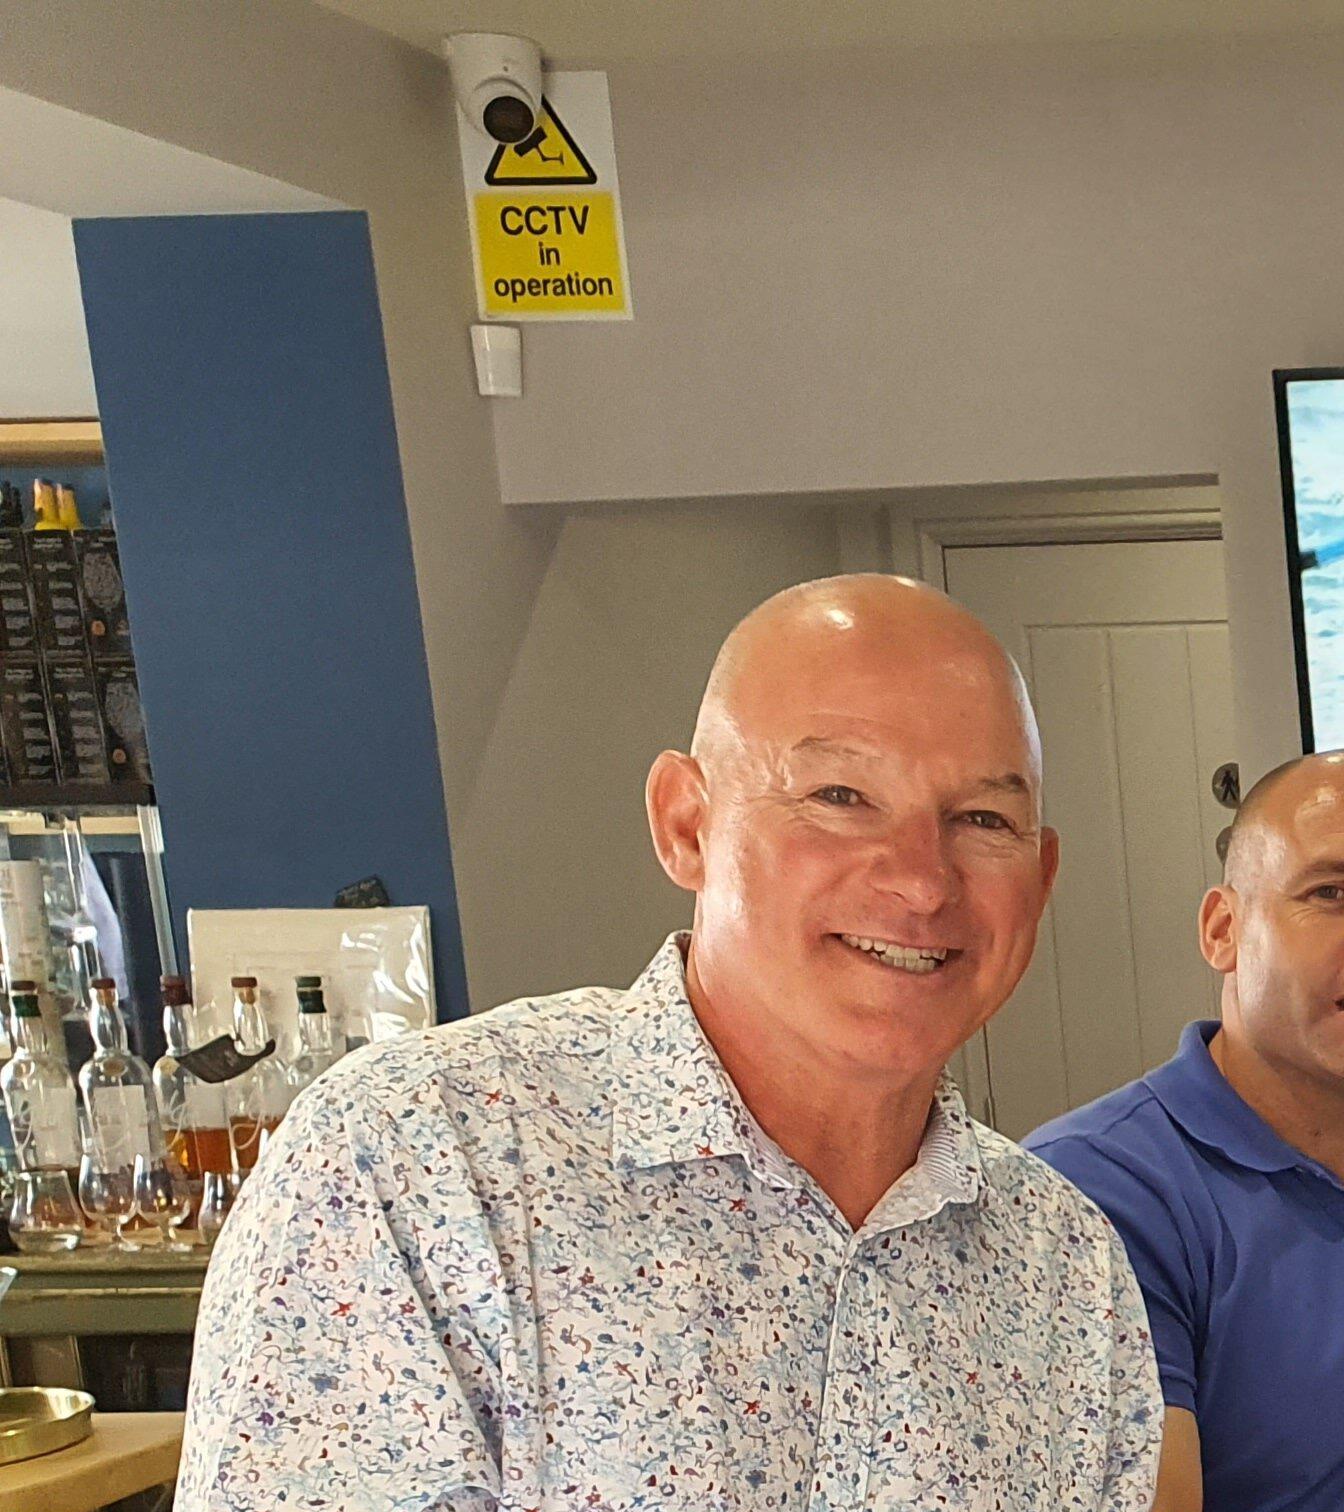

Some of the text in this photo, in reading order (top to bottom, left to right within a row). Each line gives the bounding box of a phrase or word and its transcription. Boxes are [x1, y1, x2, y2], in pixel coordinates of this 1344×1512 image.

[500, 205, 590, 236] CCTV
[538, 241, 561, 266] in
[494, 271, 614, 303] operation
